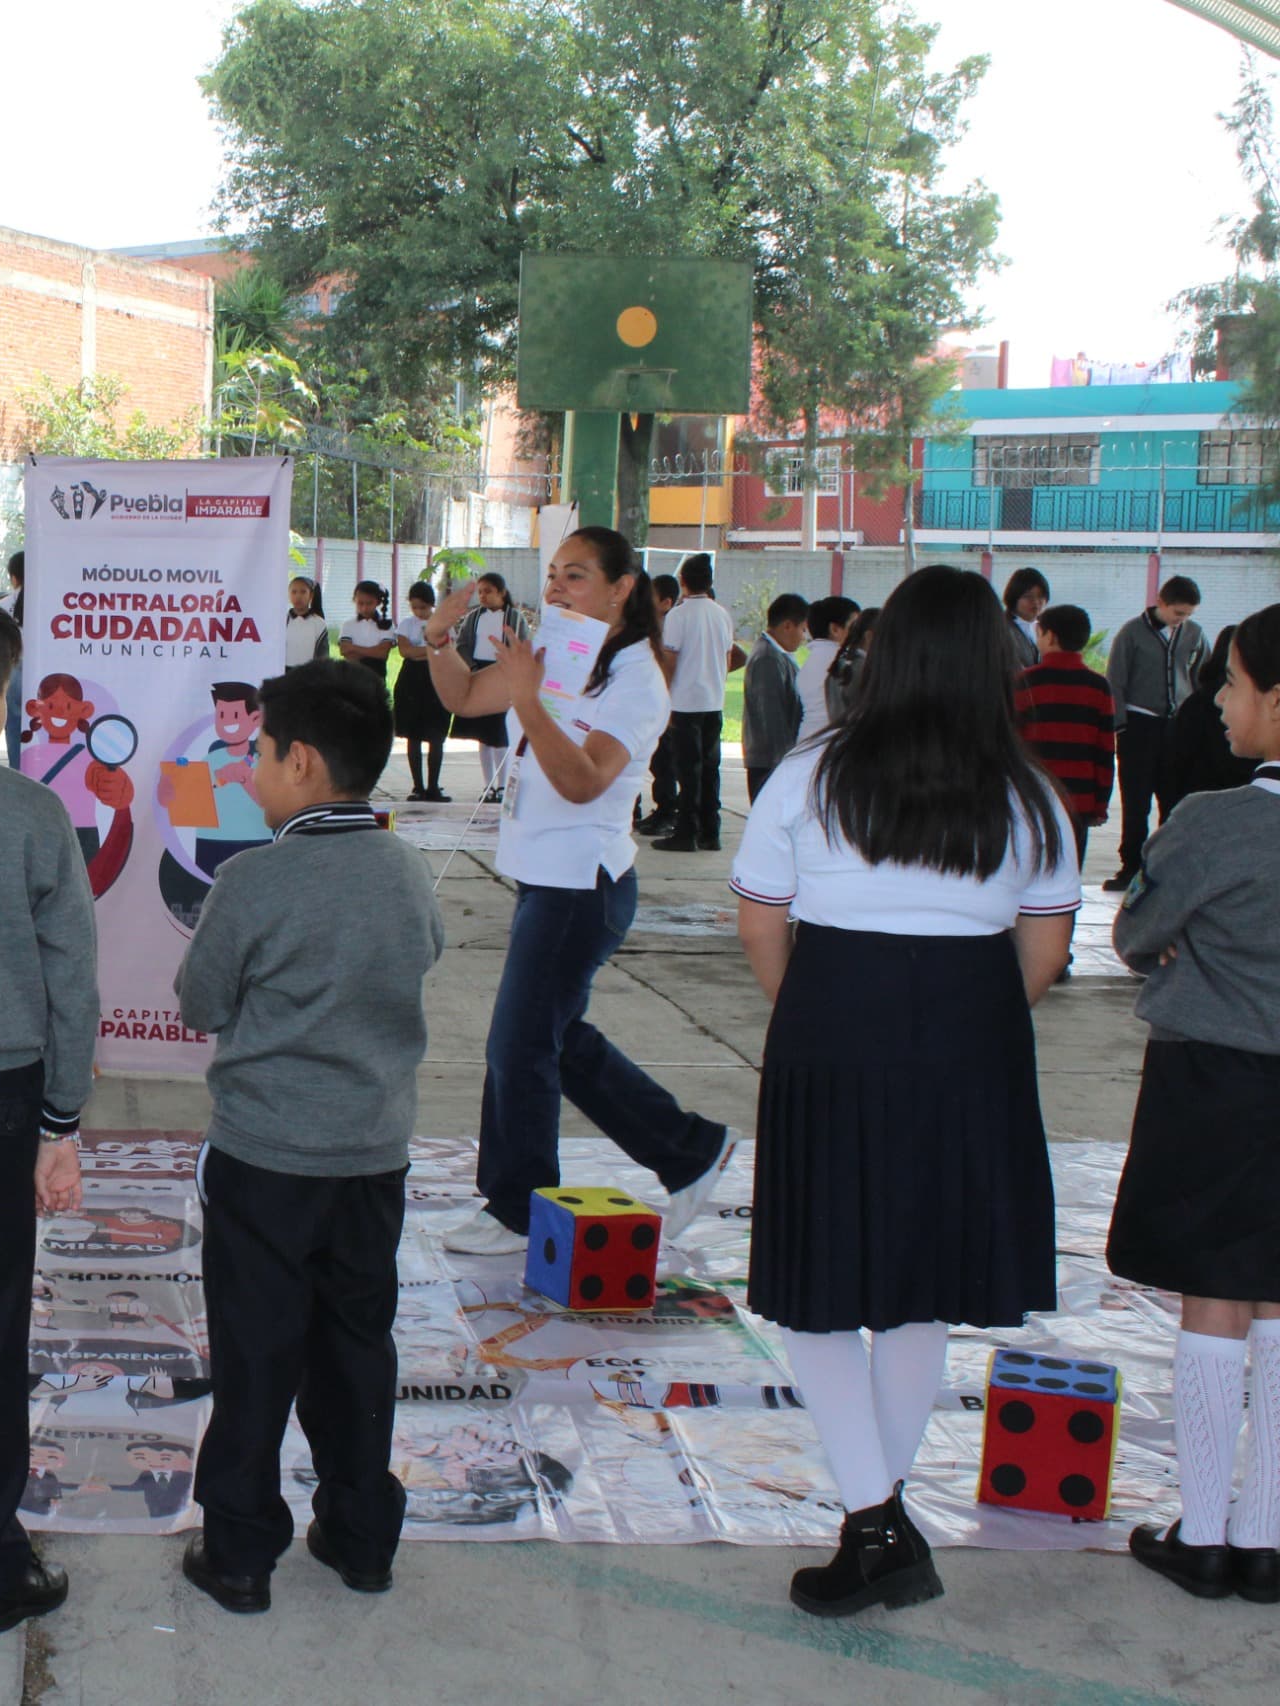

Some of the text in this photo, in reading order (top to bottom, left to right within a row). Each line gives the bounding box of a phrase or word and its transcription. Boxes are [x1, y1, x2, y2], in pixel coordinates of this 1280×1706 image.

[110, 494, 183, 513] Puebla
[195, 506, 263, 516] IMPARABLE
[82, 564, 223, 584] MÓDULO MOVIL
[62, 589, 243, 614] CONTRALORÍA
[50, 614, 262, 643] CIUDADANA
[79, 643, 228, 659] MUNICIPAL
[113, 1008, 182, 1022] CAPITA
[96, 1020, 208, 1044] PARABLE
[31, 1349, 200, 1362] ANSPARENCIA
[35, 1425, 163, 1441] RESPETO
